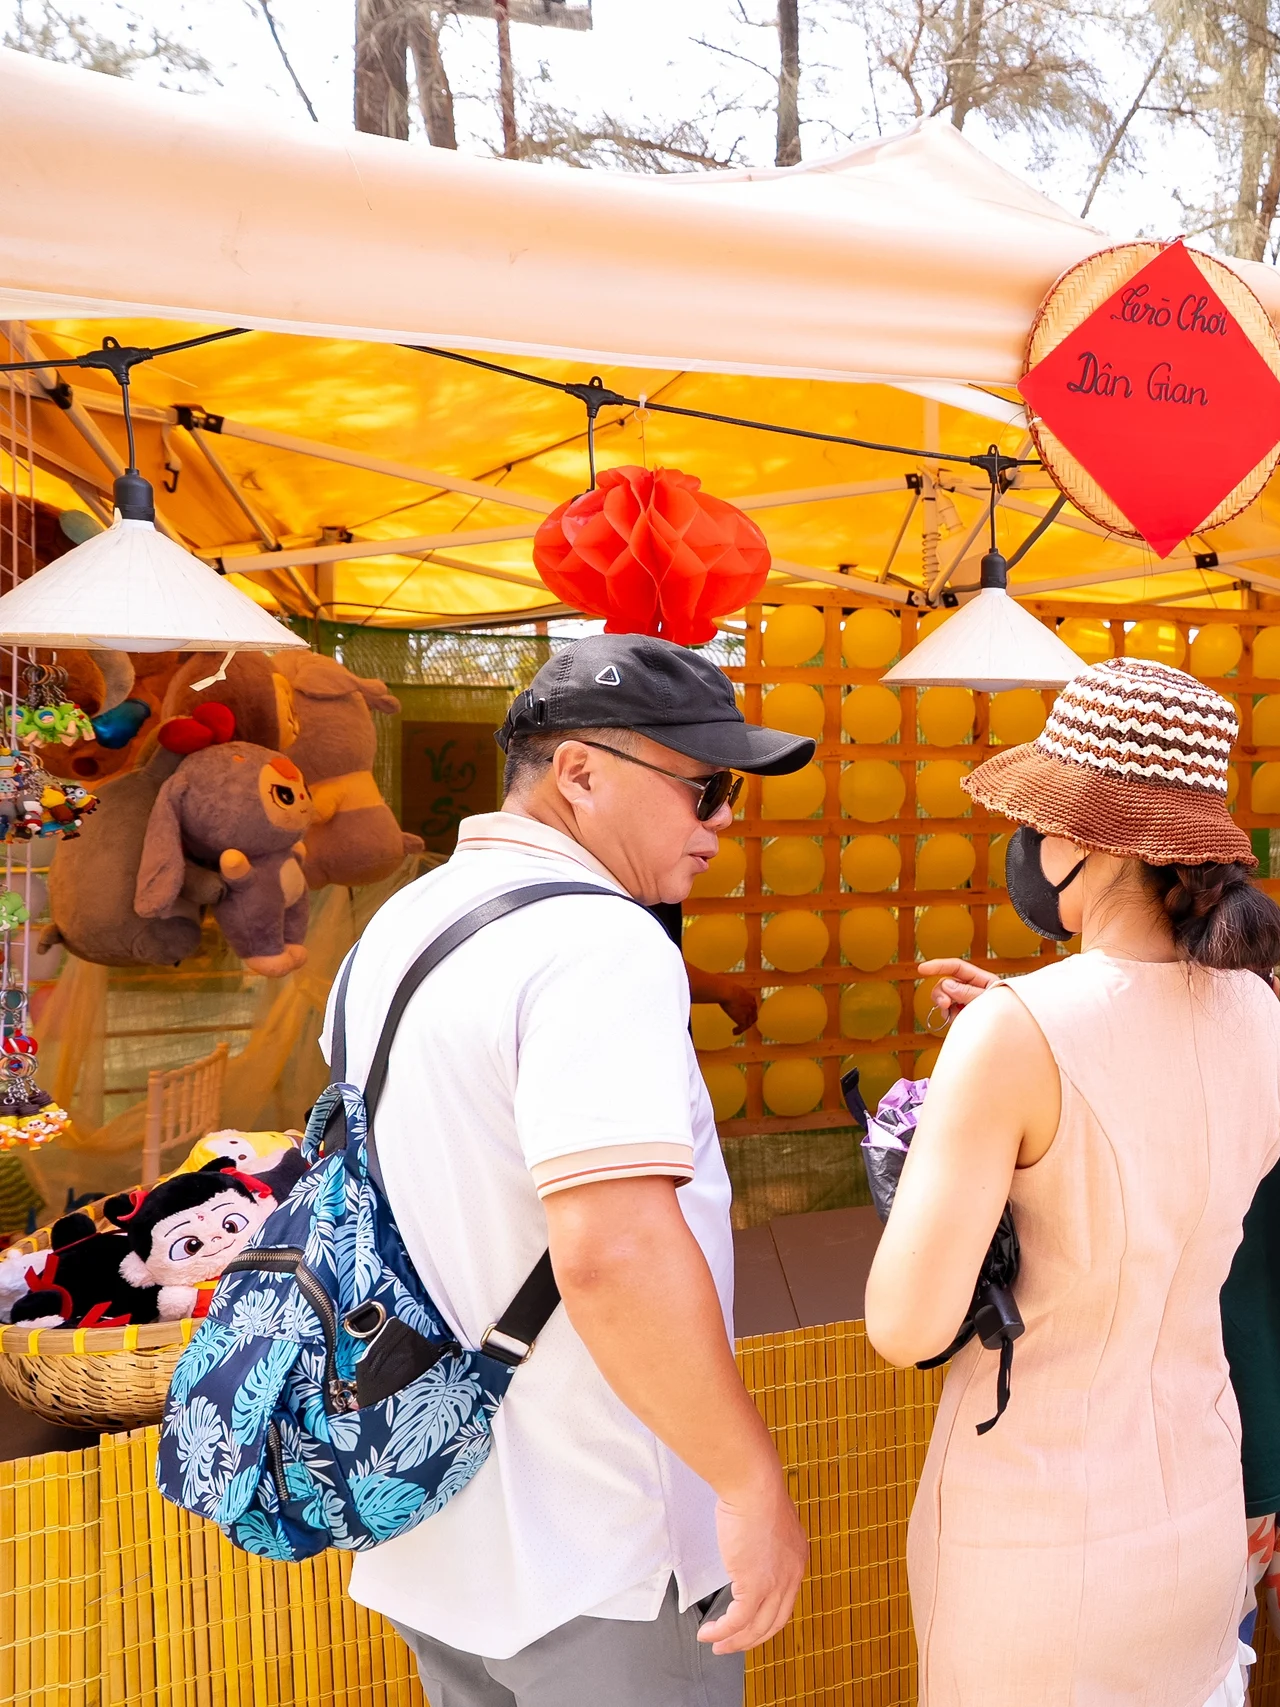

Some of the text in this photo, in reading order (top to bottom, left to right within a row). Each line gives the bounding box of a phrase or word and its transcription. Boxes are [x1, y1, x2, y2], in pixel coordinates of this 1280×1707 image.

[1177, 294, 1227, 336] Chơi
[1067, 352, 1208, 406] Dân Gian
